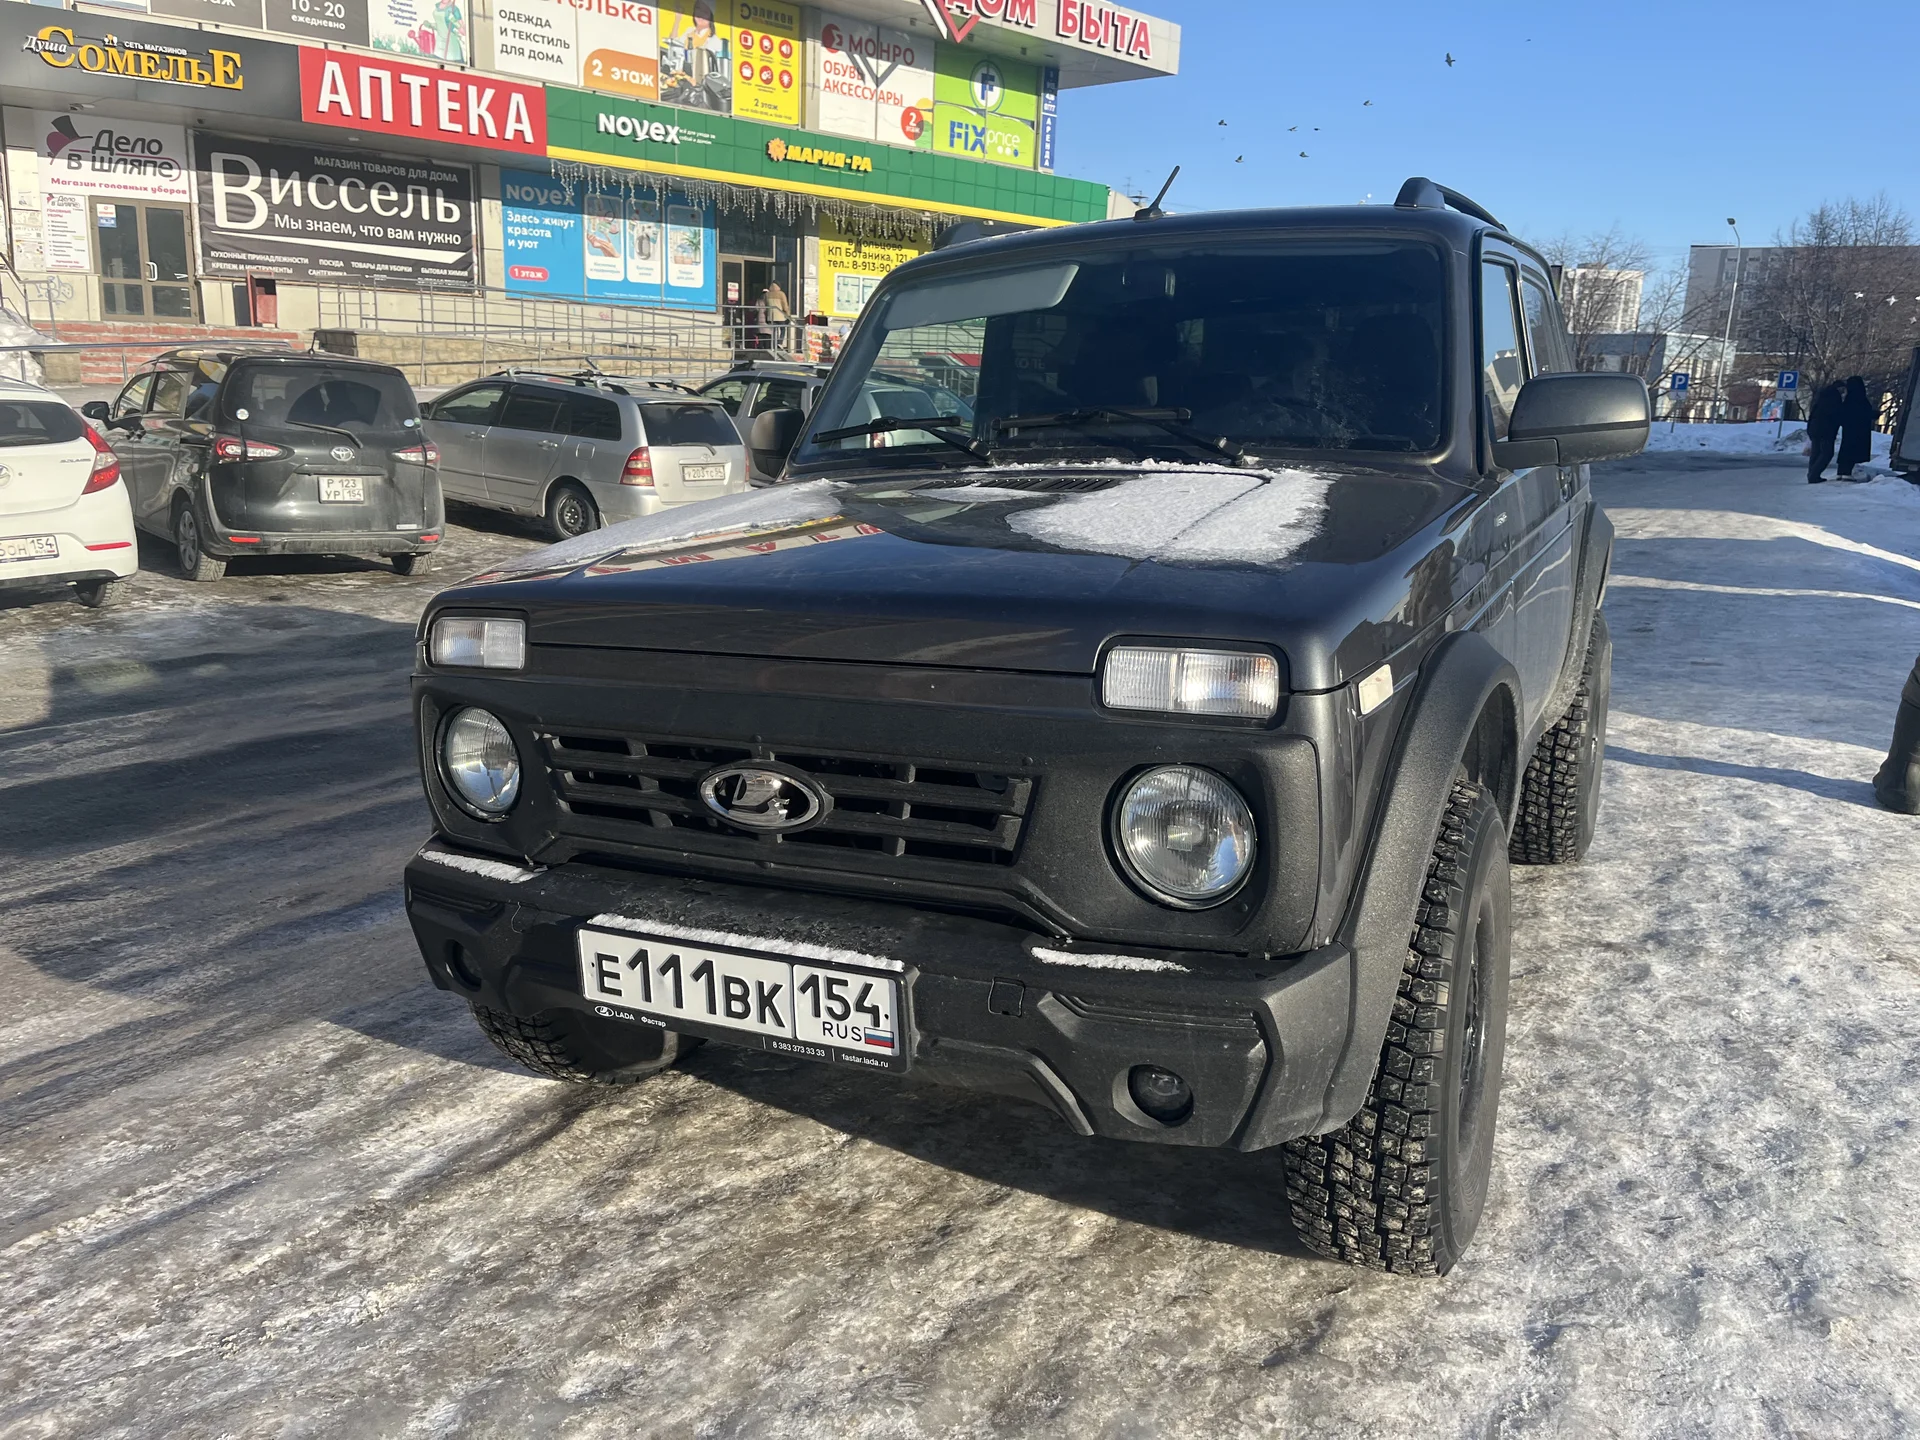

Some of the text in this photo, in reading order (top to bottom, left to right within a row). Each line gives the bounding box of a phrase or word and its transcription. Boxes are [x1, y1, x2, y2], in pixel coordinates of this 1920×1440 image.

[325, 1, 345, 19] 20
[499, 9, 552, 28] ОДЕЖДА
[291, 13, 346, 30] ежедневно
[1058, 0, 1152, 59] БЫТА
[23, 35, 67, 53] Душа
[499, 26, 570, 49] И ТЕКСТИЛЬ
[124, 41, 188, 56] СЕТЬ МАГАЗИНОВ
[500, 44, 563, 65] ДЛЯ ДОМА
[848, 34, 915, 66] МОНРО
[592, 59, 654, 87] 2 этаж
[823, 60, 864, 81] ОБУВЬ
[823, 78, 903, 106] АКСЕССУАРЫ
[317, 60, 535, 144] АПТЕКА
[754, 98, 760, 107] 2
[909, 112, 917, 127] 2
[91, 129, 163, 156] Дело
[987, 130, 1020, 146] price
[1043, 117, 1052, 167] АРЕНДА
[91, 155, 173, 178] шляпе
[786, 144, 873, 173] МАРИЯ-РА
[313, 156, 459, 183] МАГАЗИН ТОВАРОВ ДЛЯ ДОМА
[51, 177, 187, 195] Магазин головных уборов
[210, 151, 462, 231] Виссель
[506, 210, 575, 229] Здесь живут
[274, 213, 462, 246] Мы знаем, что вам нужно
[507, 226, 552, 238] красота
[508, 239, 539, 249] и уют
[856, 240, 903, 252] Кольцово
[210, 250, 309, 265] КУХОННЫЕ ПРИНАДЛЕЖНОСТИ
[319, 258, 344, 267] ПОСУДА
[828, 246, 908, 264] КП Ботаника, 121
[211, 262, 239, 270] КРЕПЕЖ
[351, 261, 413, 273] ТОВАРЫ ДЛЯ УБОРКИ
[421, 267, 468, 277] БЫТОВАЯ ХИМИЯ
[514, 268, 543, 279] 1 этаж
[327, 478, 356, 488] Р 123
[325, 489, 362, 499] УР 154
[29, 538, 53, 550] 154
[594, 948, 882, 1029] Е111ВК 154
[614, 1010, 666, 1028] LADA Фастар
[822, 1021, 862, 1042] RUS
[772, 1041, 825, 1057] 8 383 373 33 33
[842, 1053, 889, 1068] fastar.lada.ru
